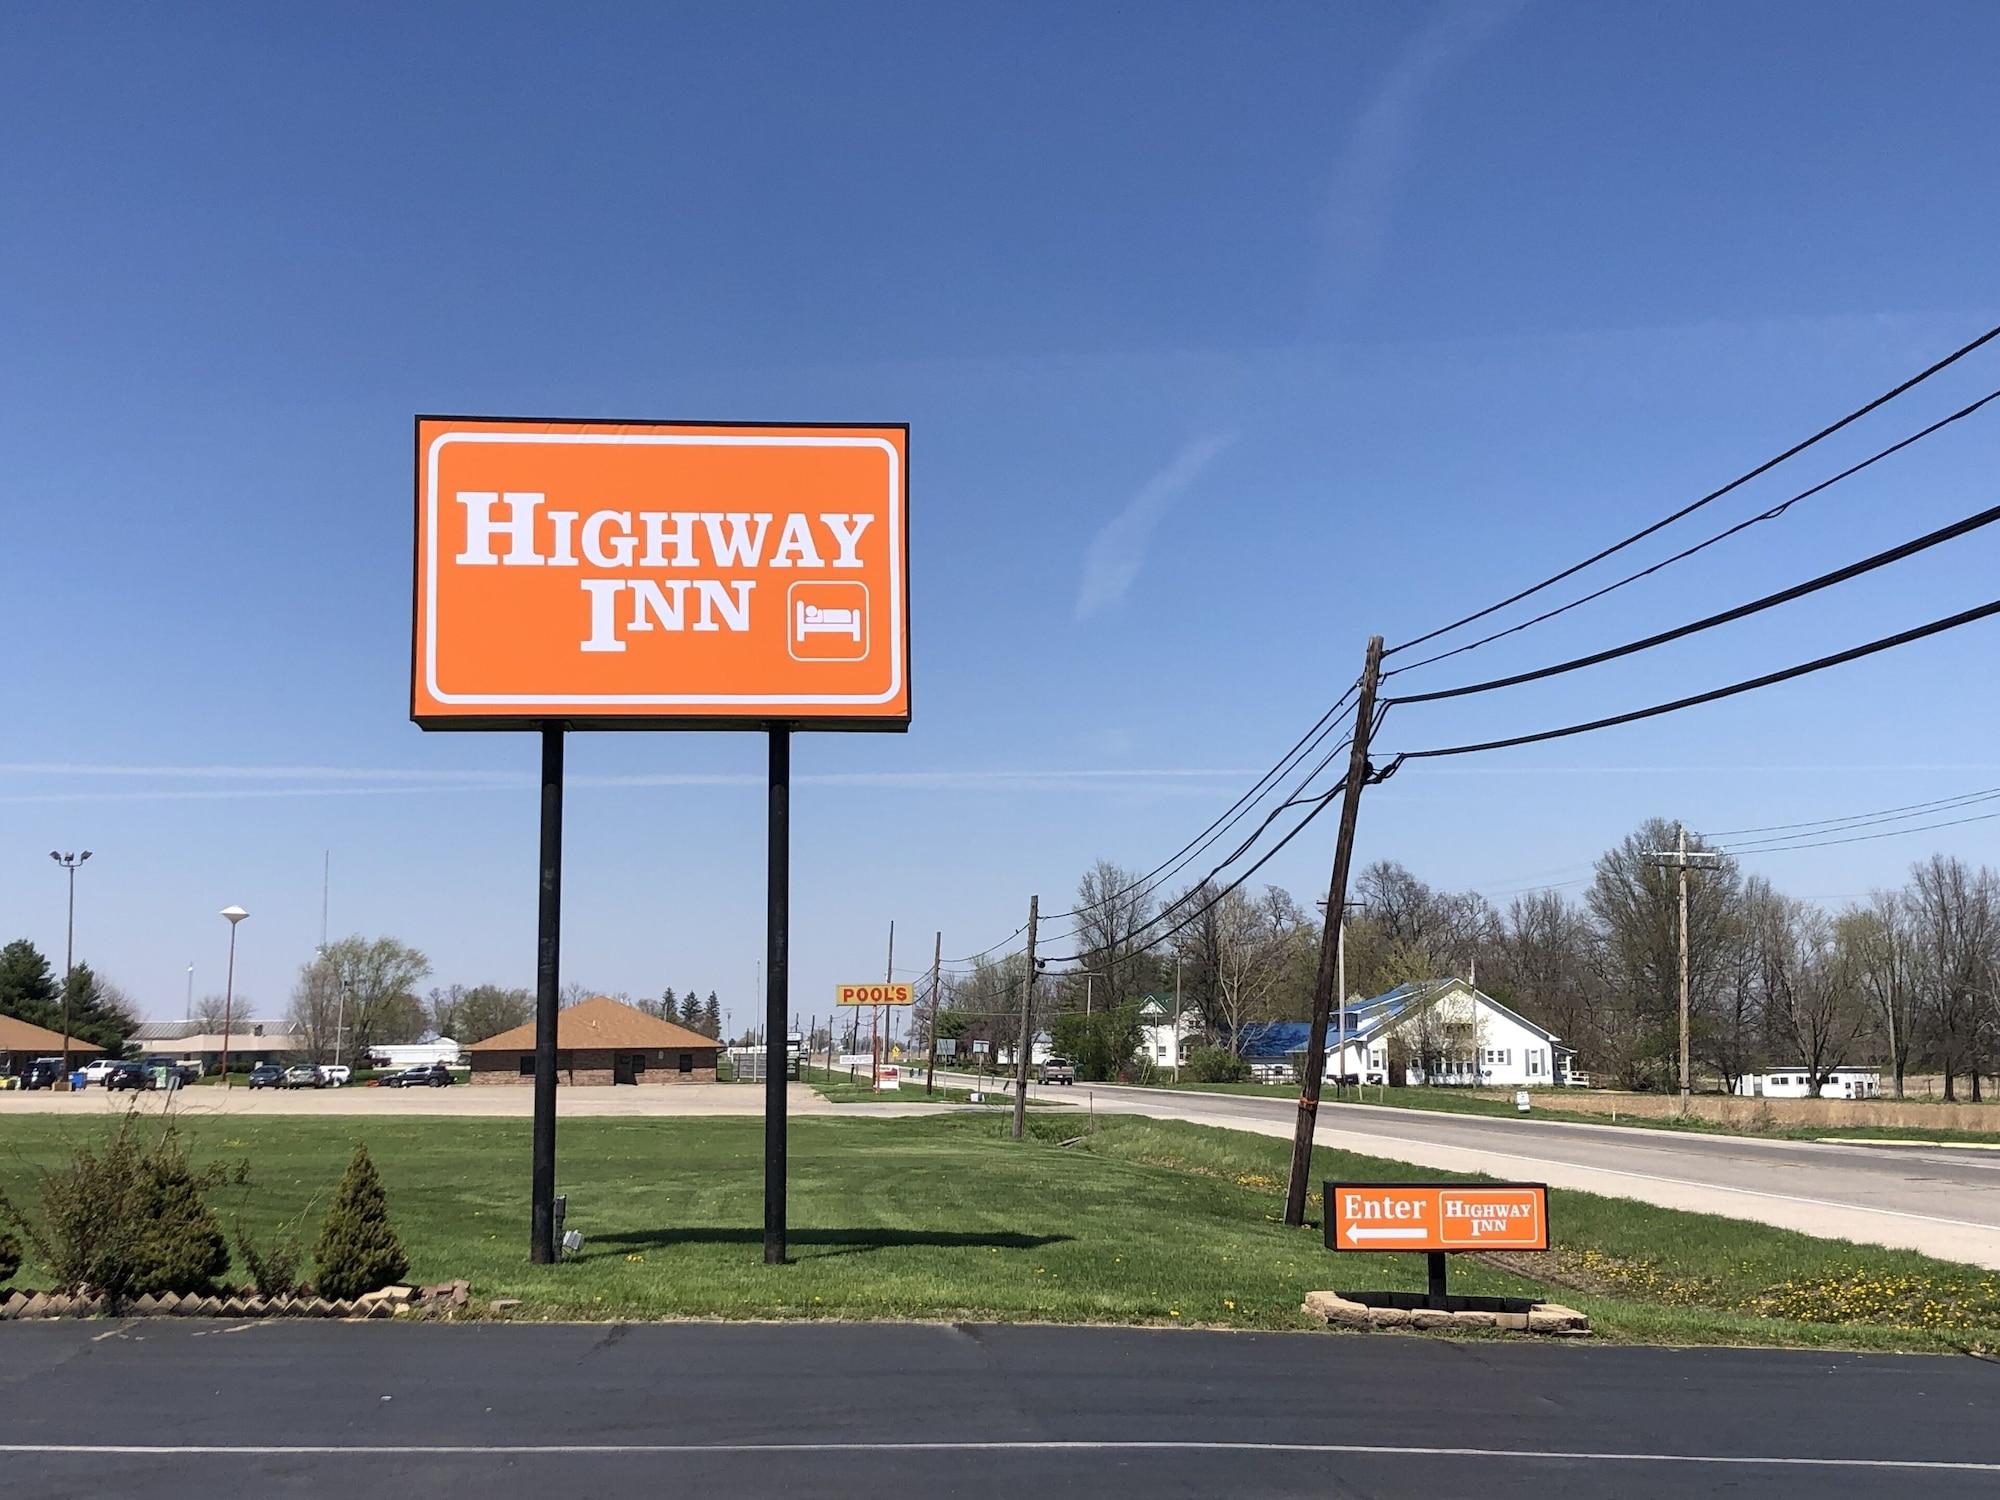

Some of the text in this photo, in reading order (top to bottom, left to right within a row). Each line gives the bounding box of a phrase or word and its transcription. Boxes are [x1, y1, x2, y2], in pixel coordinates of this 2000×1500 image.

[456, 492, 875, 568] HIGHWAY
[580, 579, 757, 652] INN
[842, 985, 908, 1002] POOL'S
[1344, 1194, 1427, 1220] Enter
[1445, 1199, 1532, 1218] HIGHWAY
[1470, 1219, 1507, 1237] INN
